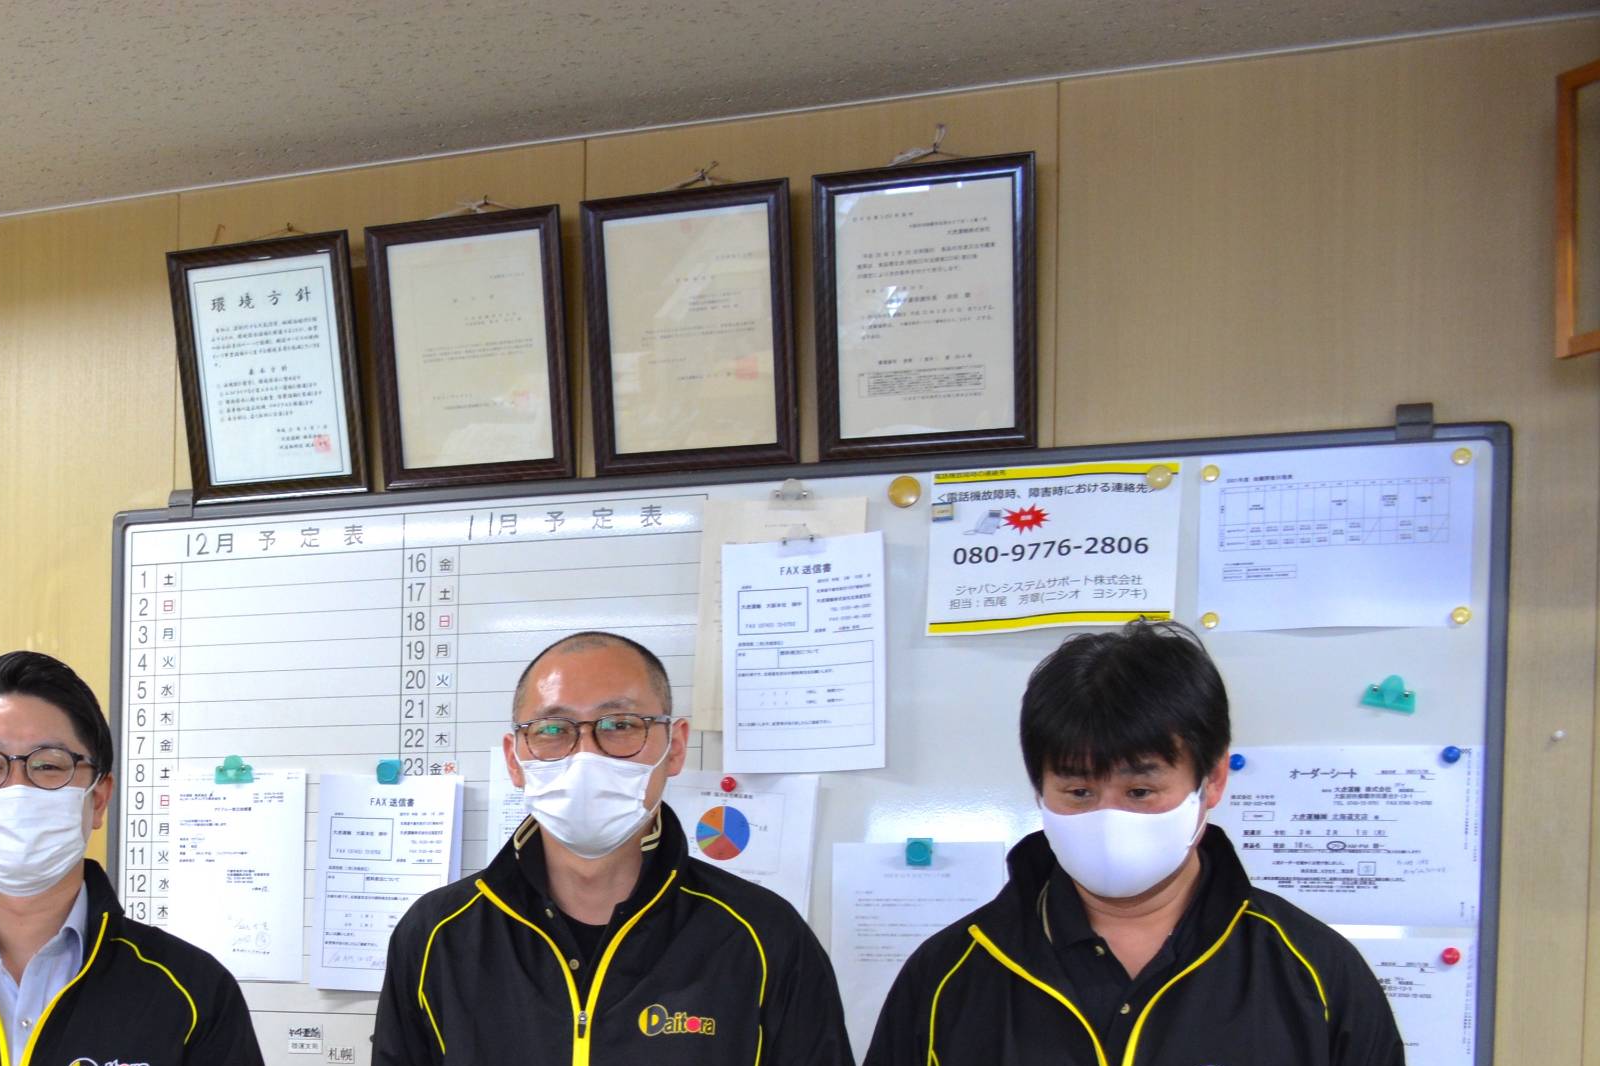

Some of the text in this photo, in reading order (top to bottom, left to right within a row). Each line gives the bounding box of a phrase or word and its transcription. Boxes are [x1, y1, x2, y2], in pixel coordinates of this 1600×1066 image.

[210, 286, 312, 313] 環境方針
[953, 536, 1149, 565] 080-9776-2806
[407, 553, 452, 573] 16 金
[780, 563, 832, 576] FAX 送信書
[140, 571, 174, 589] 1 土
[955, 575, 1143, 596] ジャパンシステムサポート株式会社
[407, 583, 451, 602] 17 土
[138, 598, 174, 616] 2 日
[406, 612, 450, 631] 18 日
[138, 626, 174, 644] 3 月
[406, 641, 449, 660] 19 月
[137, 653, 174, 671] 4 火
[405, 670, 449, 689] 20 火
[137, 681, 173, 699] 5 水
[136, 708, 172, 726] 6 木
[404, 699, 449, 719] 21 水
[136, 736, 172, 754] 7 金
[404, 729, 448, 748] 22 木
[135, 764, 171, 782] 8 土
[403, 757, 424, 776] 23
[1289, 768, 1357, 779] オーダーシート
[135, 792, 145, 810] 9
[160, 794, 169, 806] 日
[370, 798, 414, 807] FAX 送信書
[130, 819, 169, 837] 10 月
[129, 847, 169, 865] 11 火
[129, 875, 169, 893] 12 水
[129, 902, 168, 920] 13 木
[638, 1003, 716, 1037] Daitora
[328, 1047, 353, 1061] 札幌
